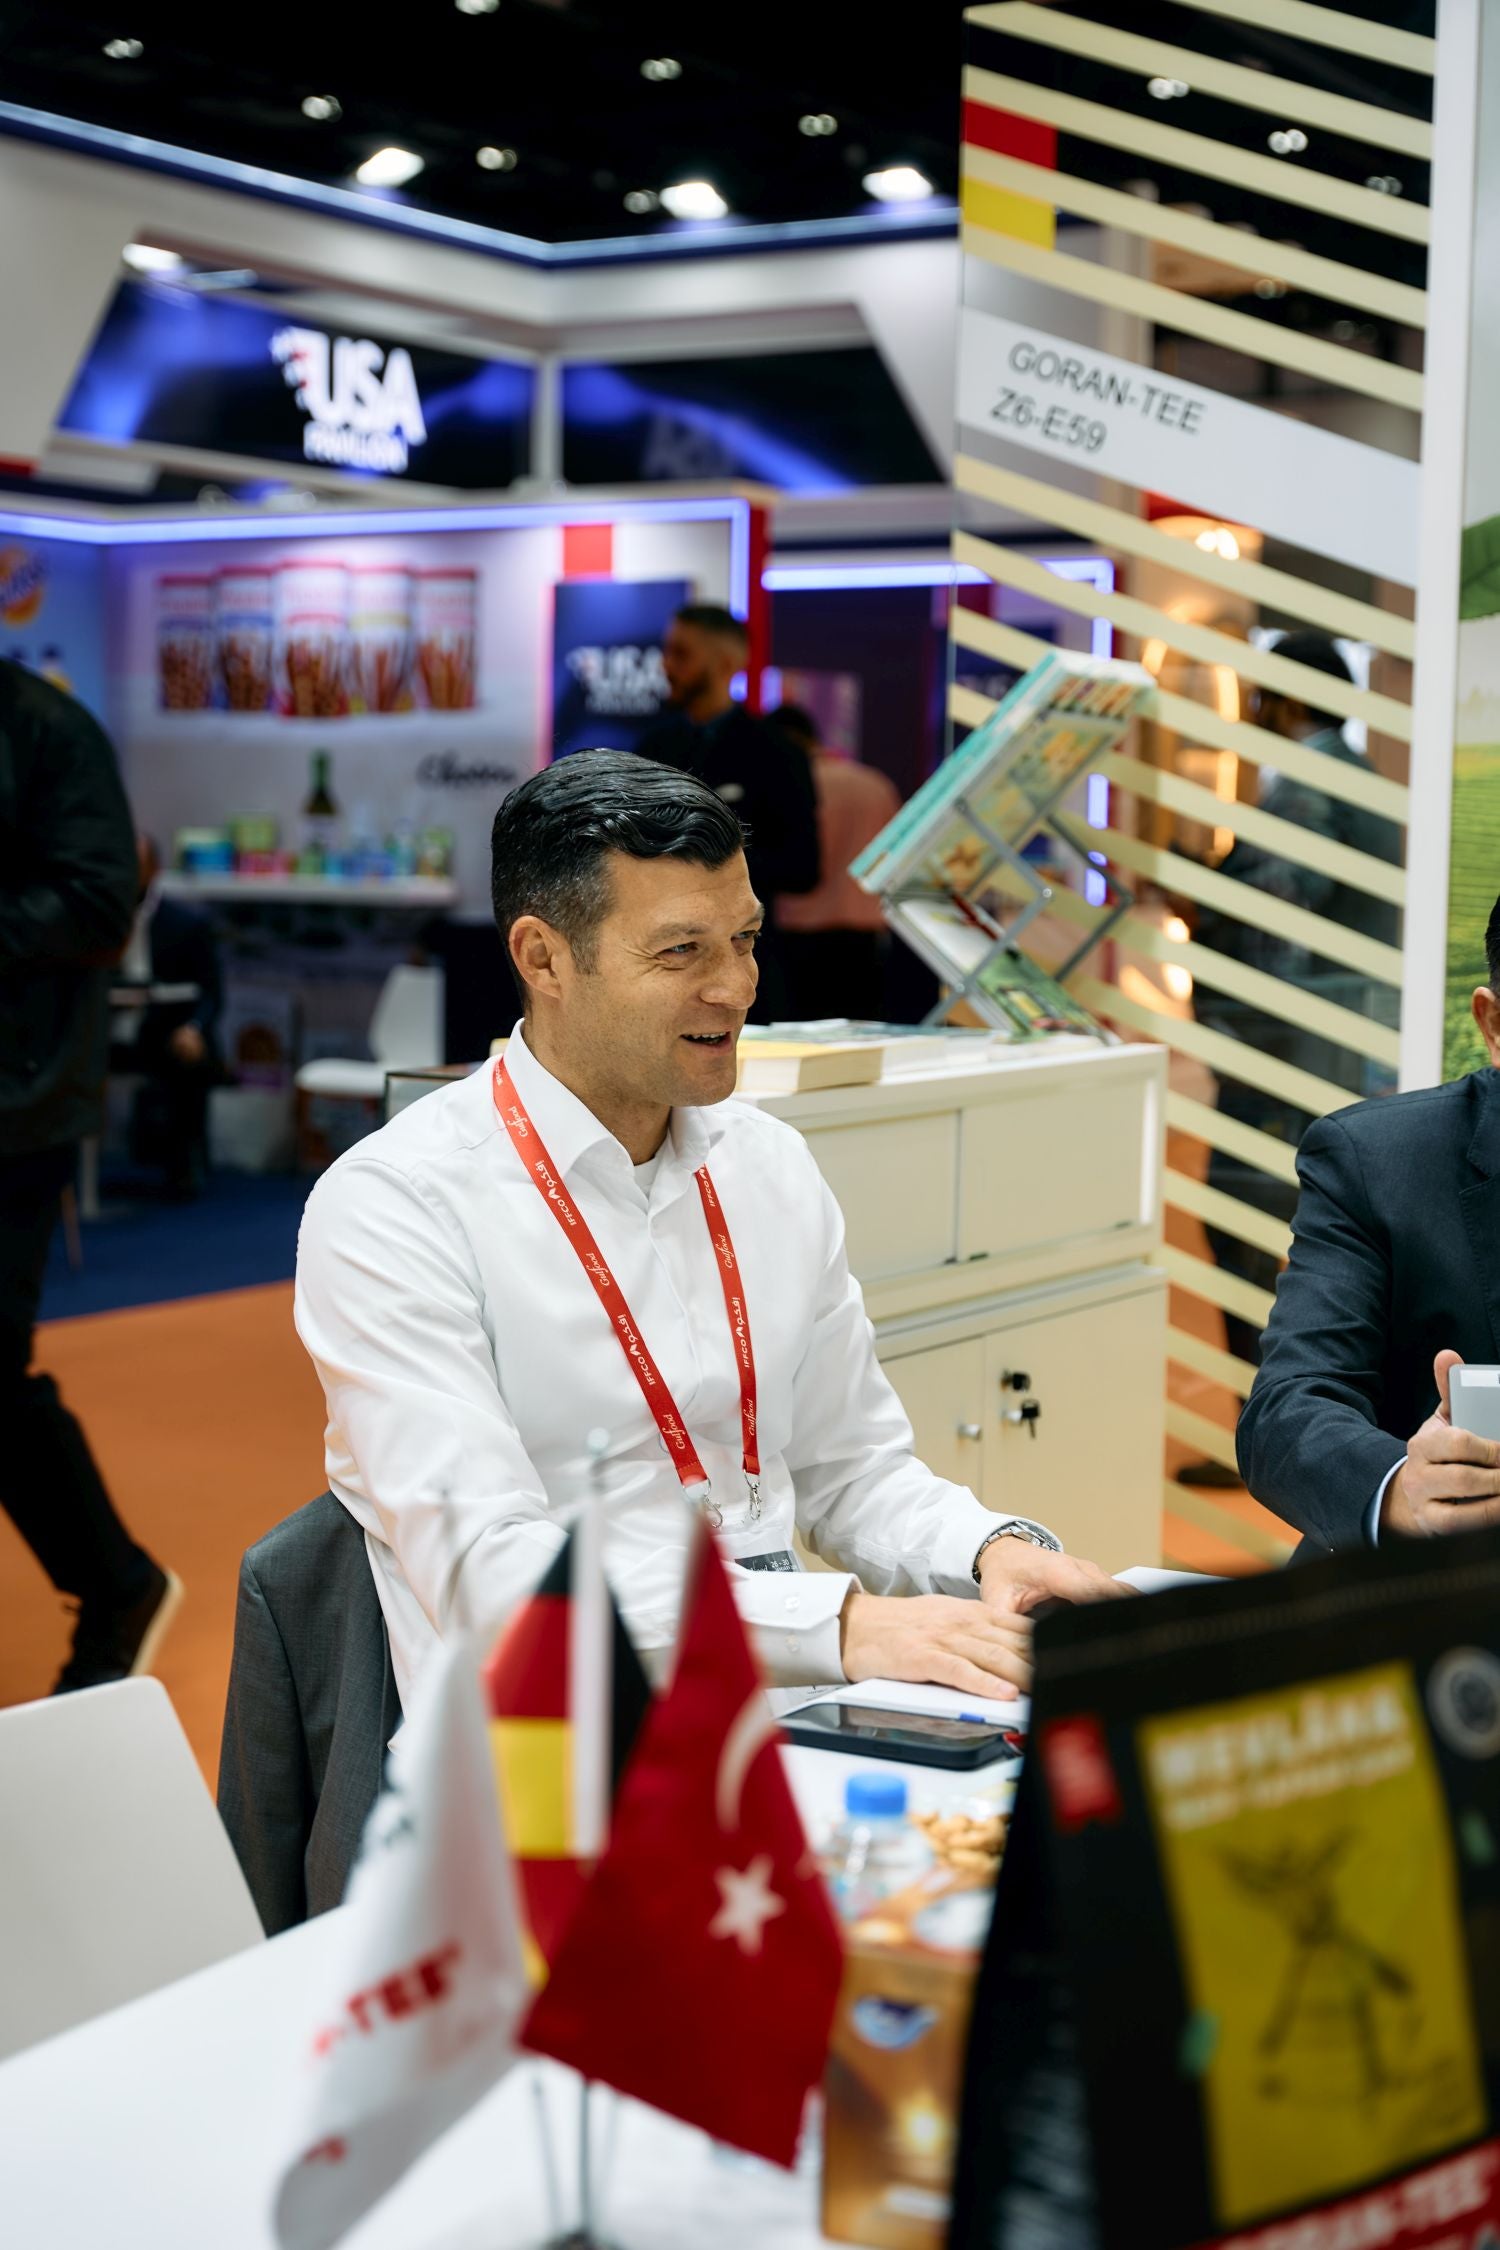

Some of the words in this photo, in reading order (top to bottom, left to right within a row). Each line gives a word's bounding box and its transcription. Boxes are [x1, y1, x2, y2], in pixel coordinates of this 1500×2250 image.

[280, 327, 427, 446] USA
[1008, 341, 1206, 435] GORAN-TEE
[990, 386, 1107, 452] Z6-E59
[507, 1106, 528, 1137] Gulfood
[702, 1178, 716, 1207] IFFCO
[557, 1198, 577, 1226] IFFCO
[715, 1234, 735, 1269] Gulfood
[585, 1252, 610, 1287] Gulfood
[637, 1355, 656, 1386] IFFCO
[737, 1338, 750, 1368] IFFCO
[662, 1413, 686, 1450] Gulfood
[742, 1398, 755, 1436] Gulfood
